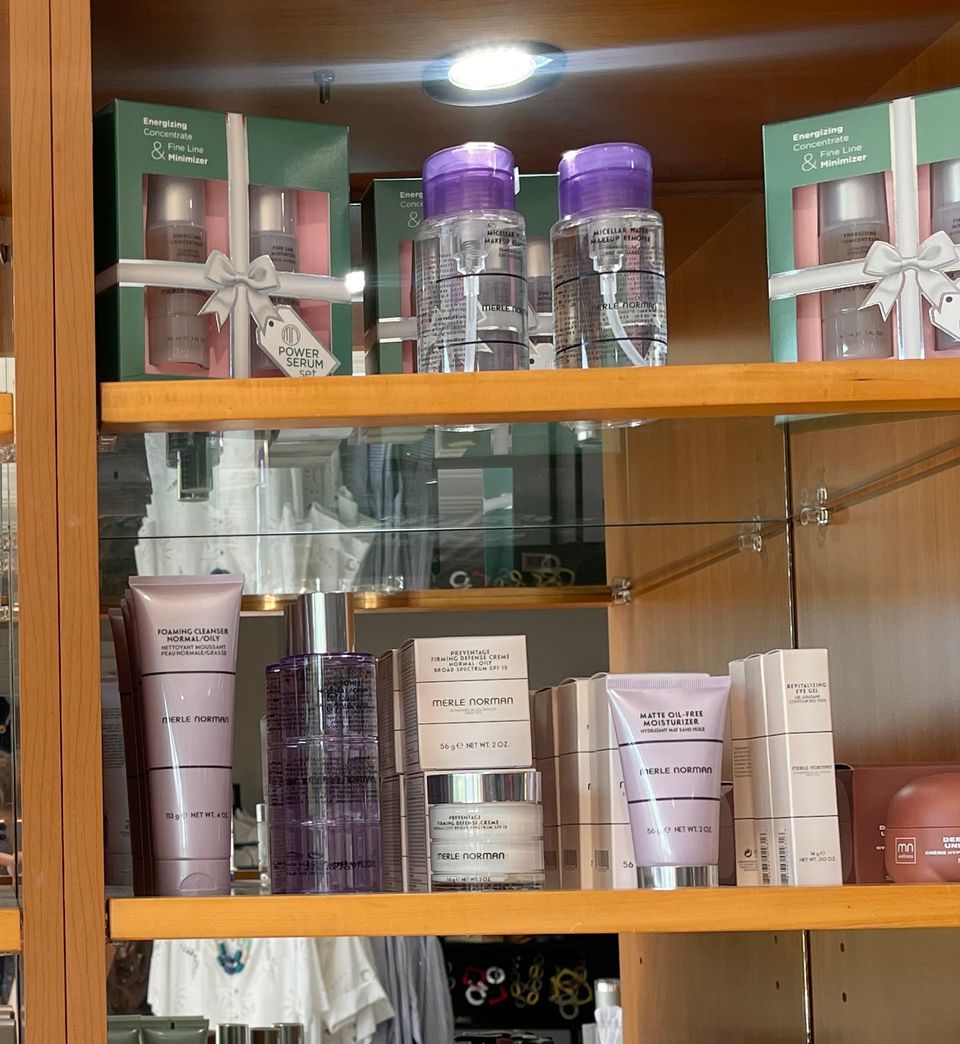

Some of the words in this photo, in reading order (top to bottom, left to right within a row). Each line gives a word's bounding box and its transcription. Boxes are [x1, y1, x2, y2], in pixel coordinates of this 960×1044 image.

[143, 117, 188, 130] Energizing
[143, 128, 193, 141] Concentrate
[792, 125, 844, 142] Energizing
[168, 142, 185, 152] Fine
[187, 145, 204, 154] Line
[793, 135, 849, 152] Concentrate
[151, 141, 166, 160] &
[820, 149, 840, 158] Fine
[842, 144, 863, 154] Line
[168, 153, 208, 165] Minimizer
[801, 152, 817, 172] &
[820, 154, 867, 169] Minimizer
[593, 227, 627, 236] MICELLAR
[590, 235, 621, 244] MAKEUP
[623, 234, 651, 243] REMOVER
[278, 346, 319, 359] POWER
[286, 357, 324, 369] SERUM
[166, 634, 221, 643] NORMAL/OILY
[432, 698, 466, 707] MERLE
[469, 697, 514, 706] NORMAN
[640, 712, 666, 720] MATTE
[668, 710, 704, 719] OIL-FREE
[643, 718, 699, 727] MOISTURIZER
